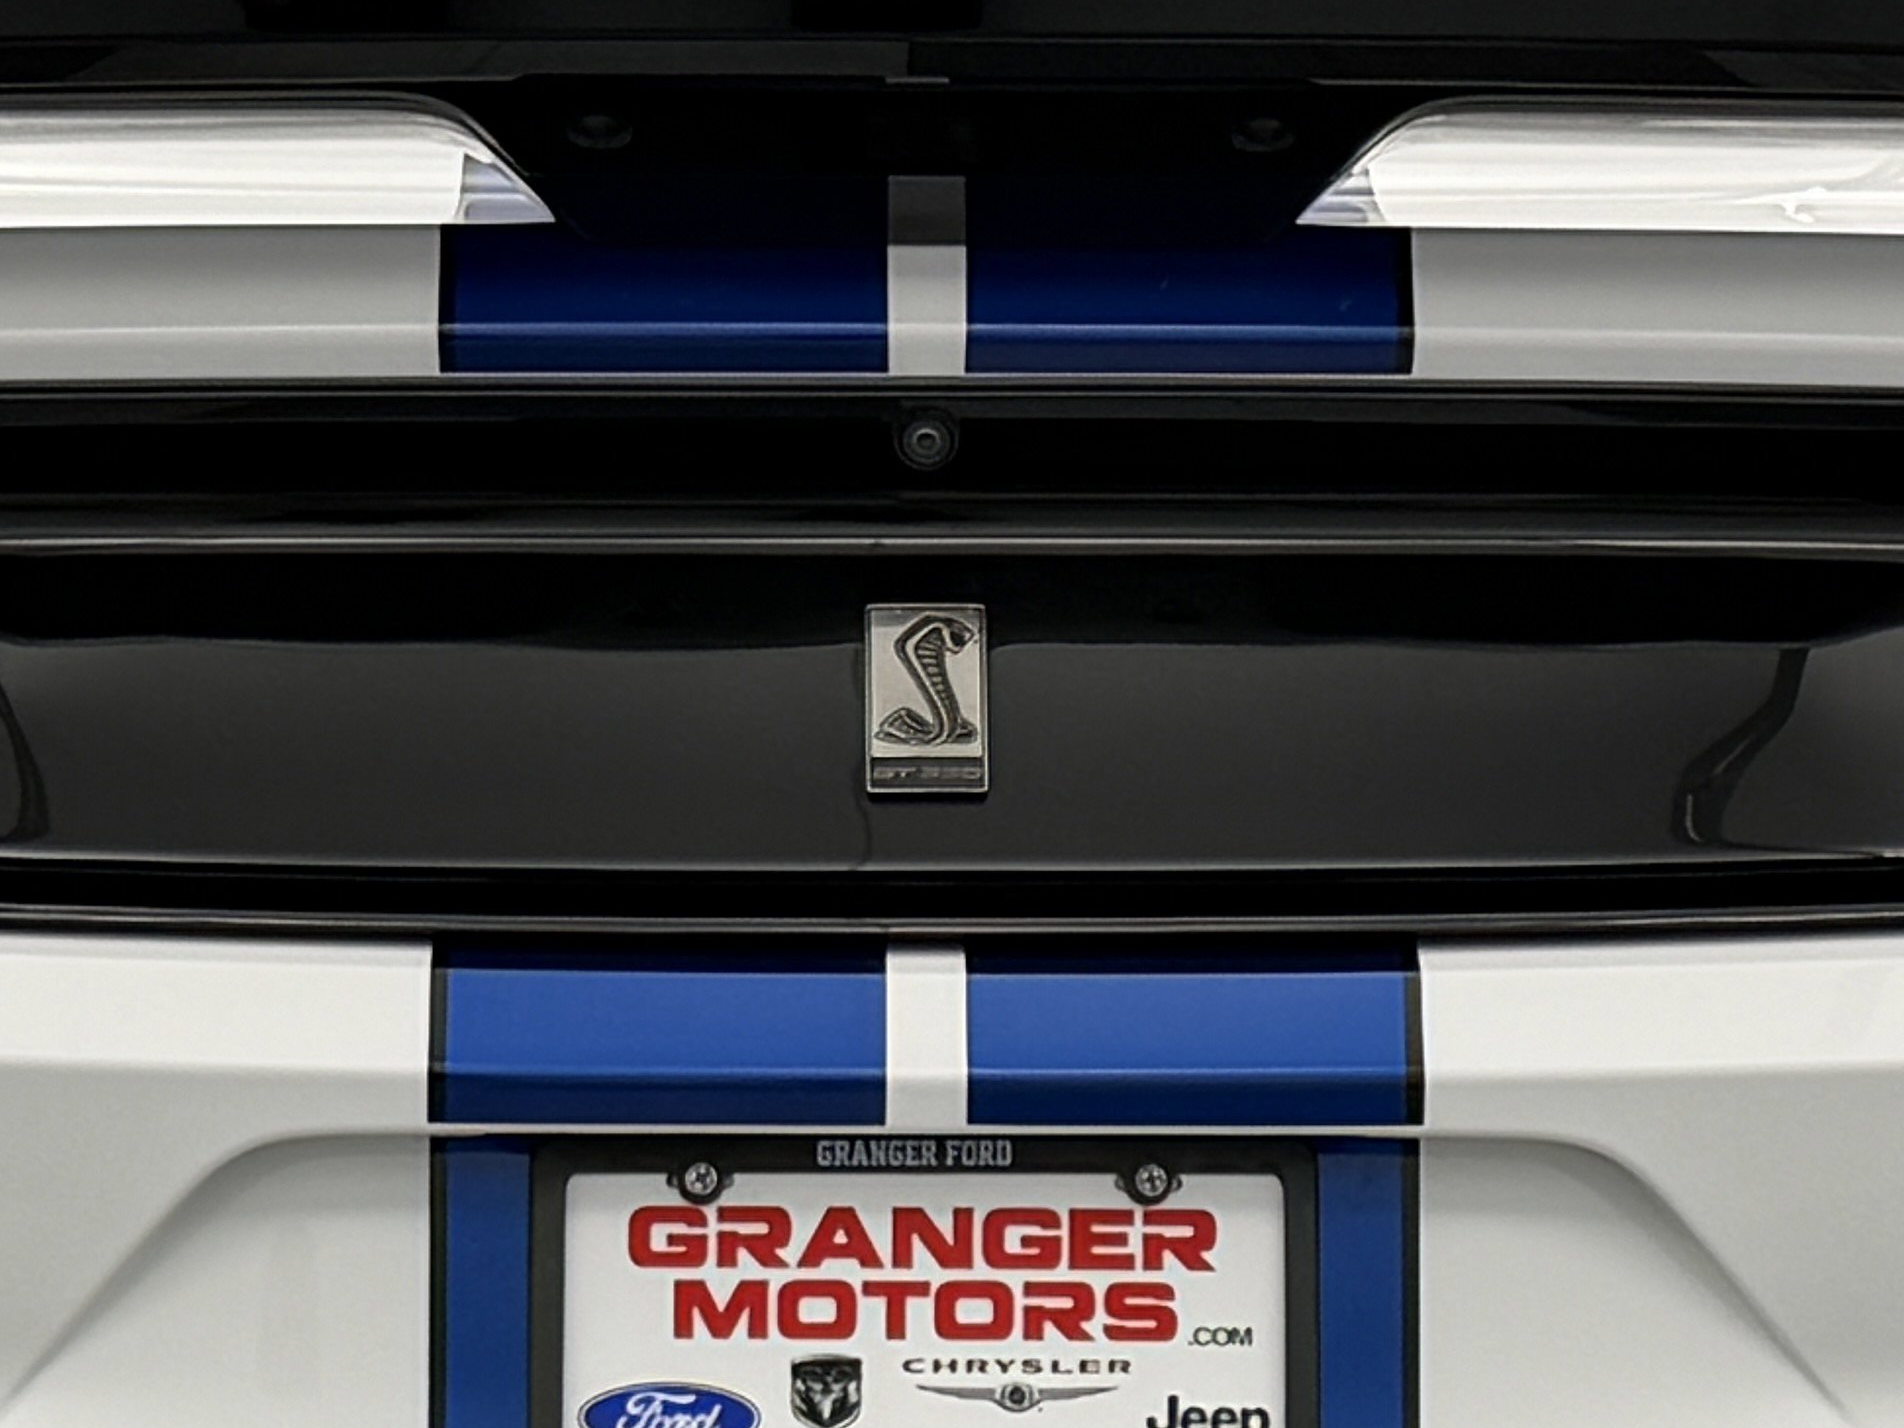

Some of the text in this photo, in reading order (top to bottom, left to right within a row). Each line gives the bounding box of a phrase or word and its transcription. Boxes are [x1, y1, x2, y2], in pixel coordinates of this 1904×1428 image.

[817, 1141, 1012, 1168] GRANGER FORD
[628, 1205, 1218, 1271] GRANGER
[673, 1280, 1253, 1347] MOTORS .COM
[903, 1358, 1132, 1375] CHRYSLER
